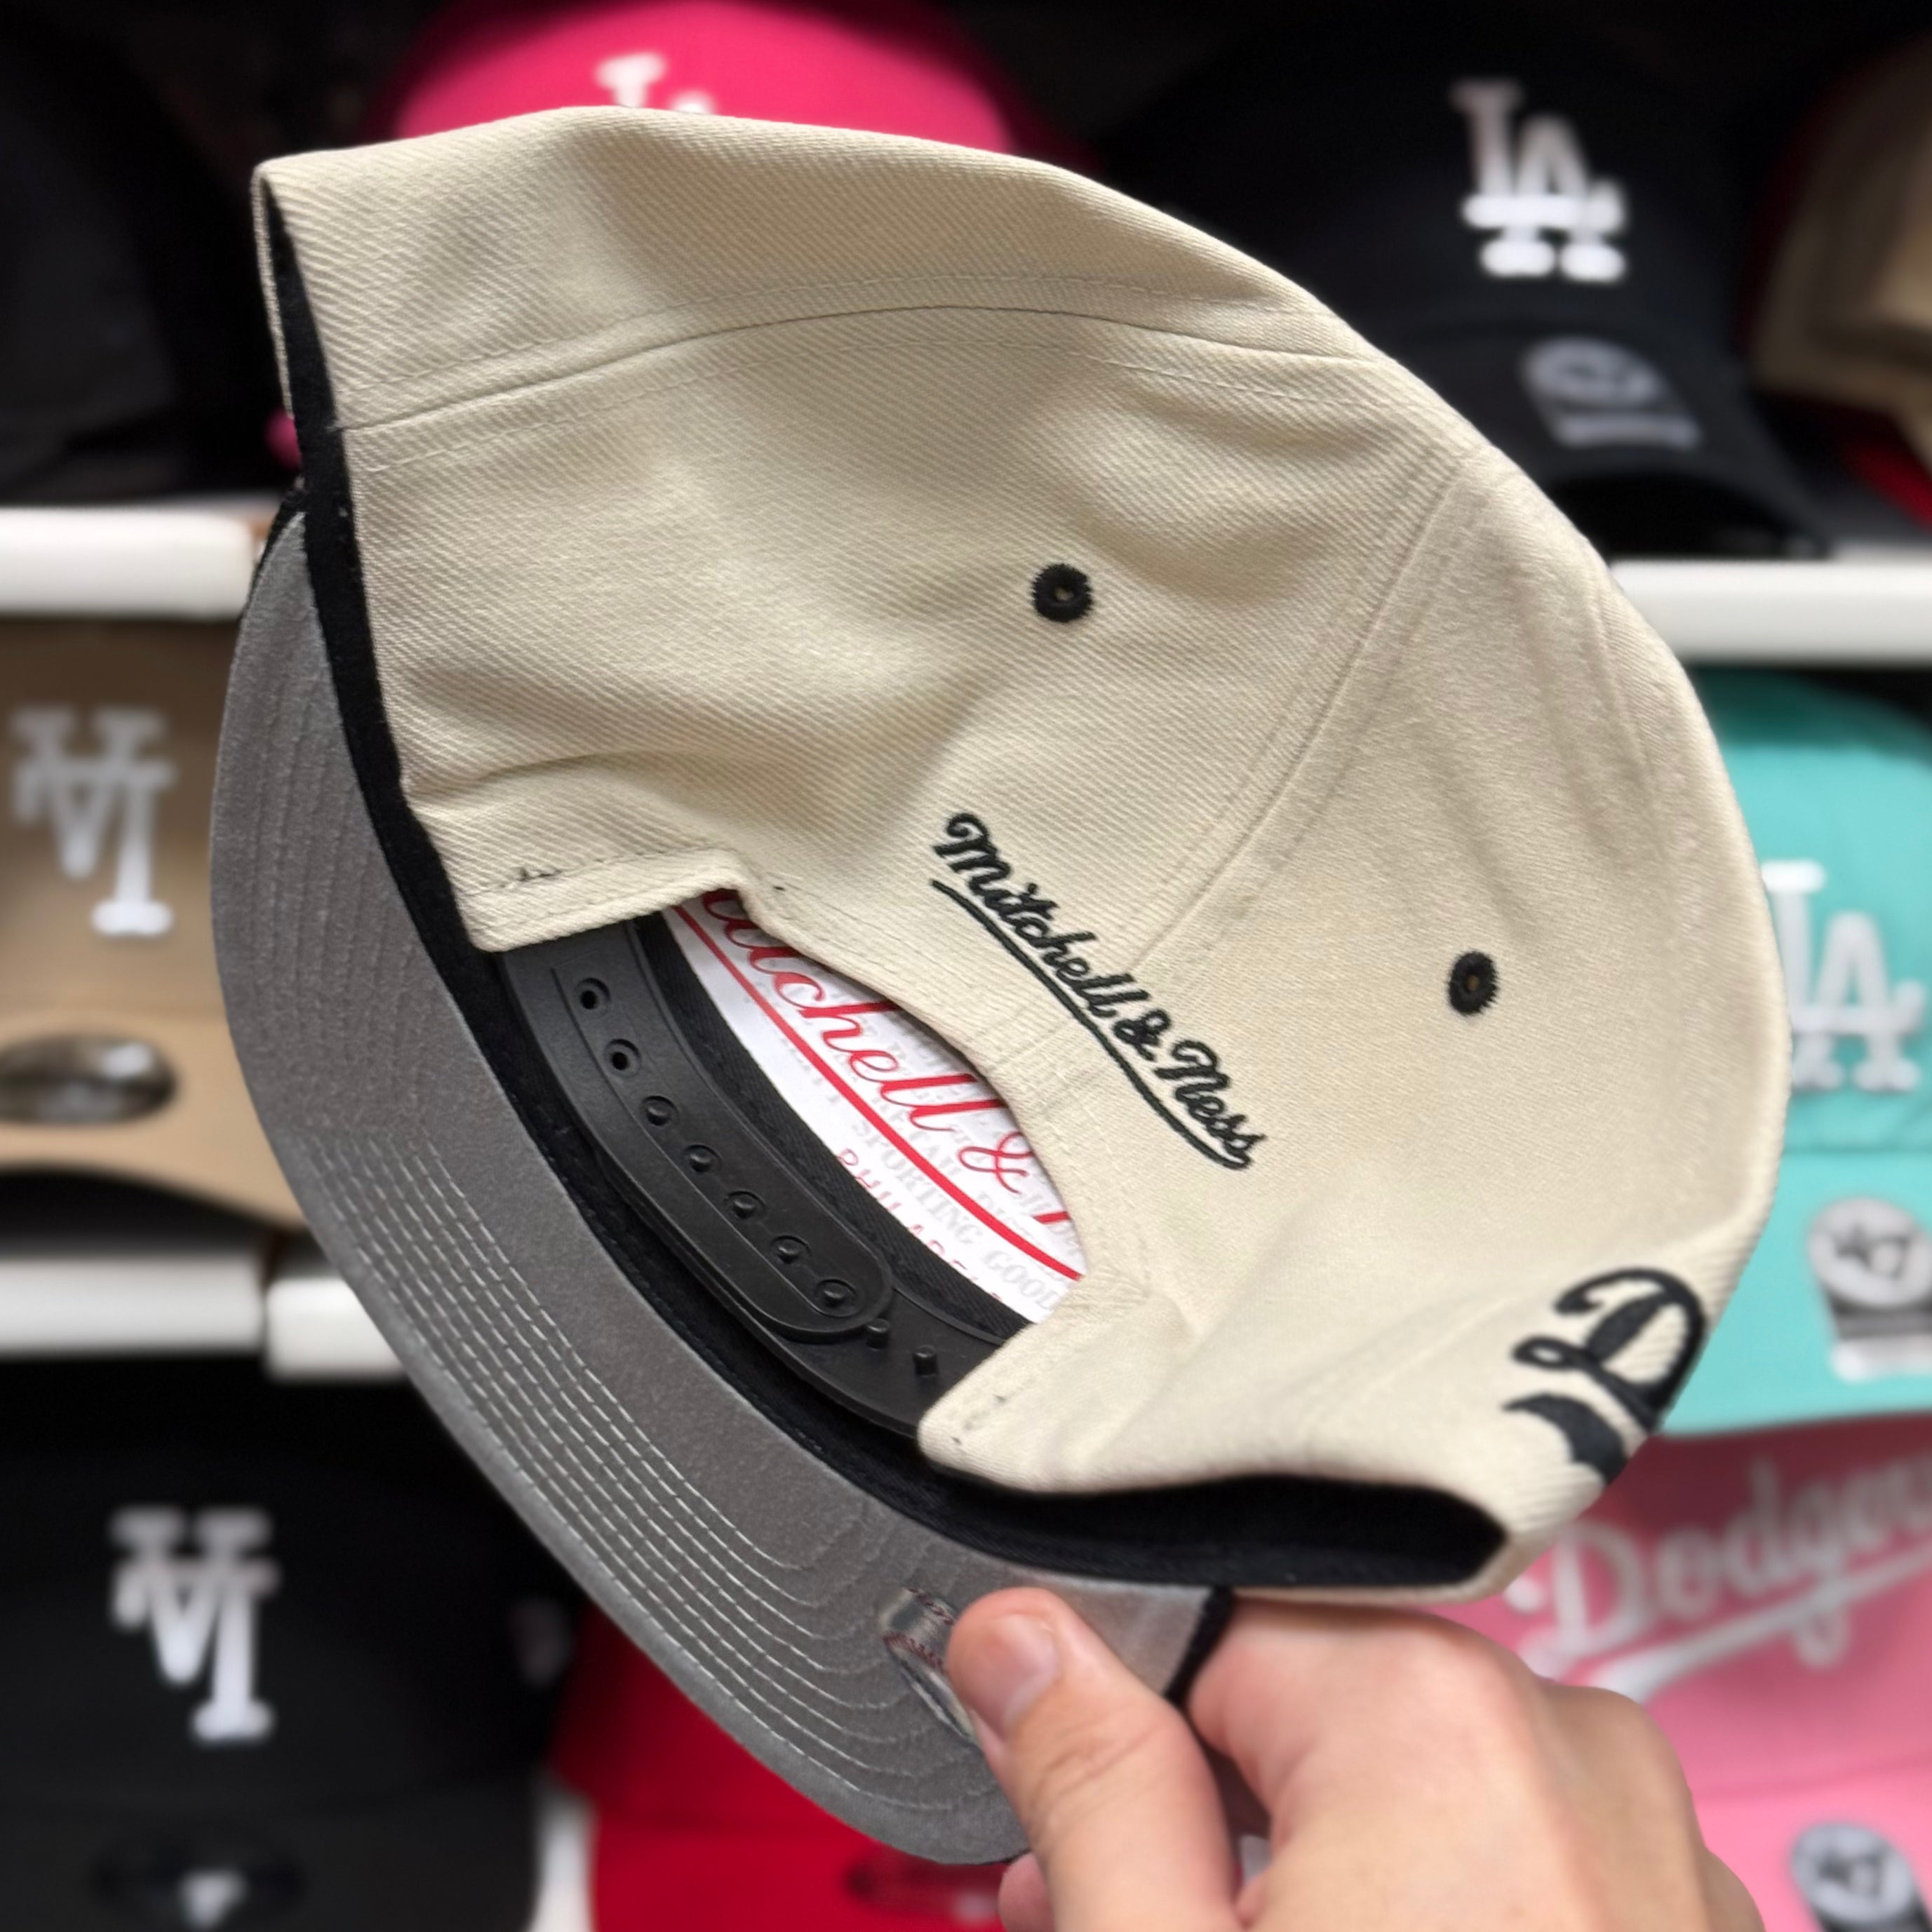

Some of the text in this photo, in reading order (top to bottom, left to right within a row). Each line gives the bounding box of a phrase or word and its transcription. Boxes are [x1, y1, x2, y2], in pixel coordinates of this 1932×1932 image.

[1452, 80, 1625, 281] LA
[931, 812, 1268, 1161] Mitchell & Ness
[1759, 858, 1926, 1094] LA
[851, 1120, 984, 1245] SPORTING
[957, 1130, 1034, 1195] &
